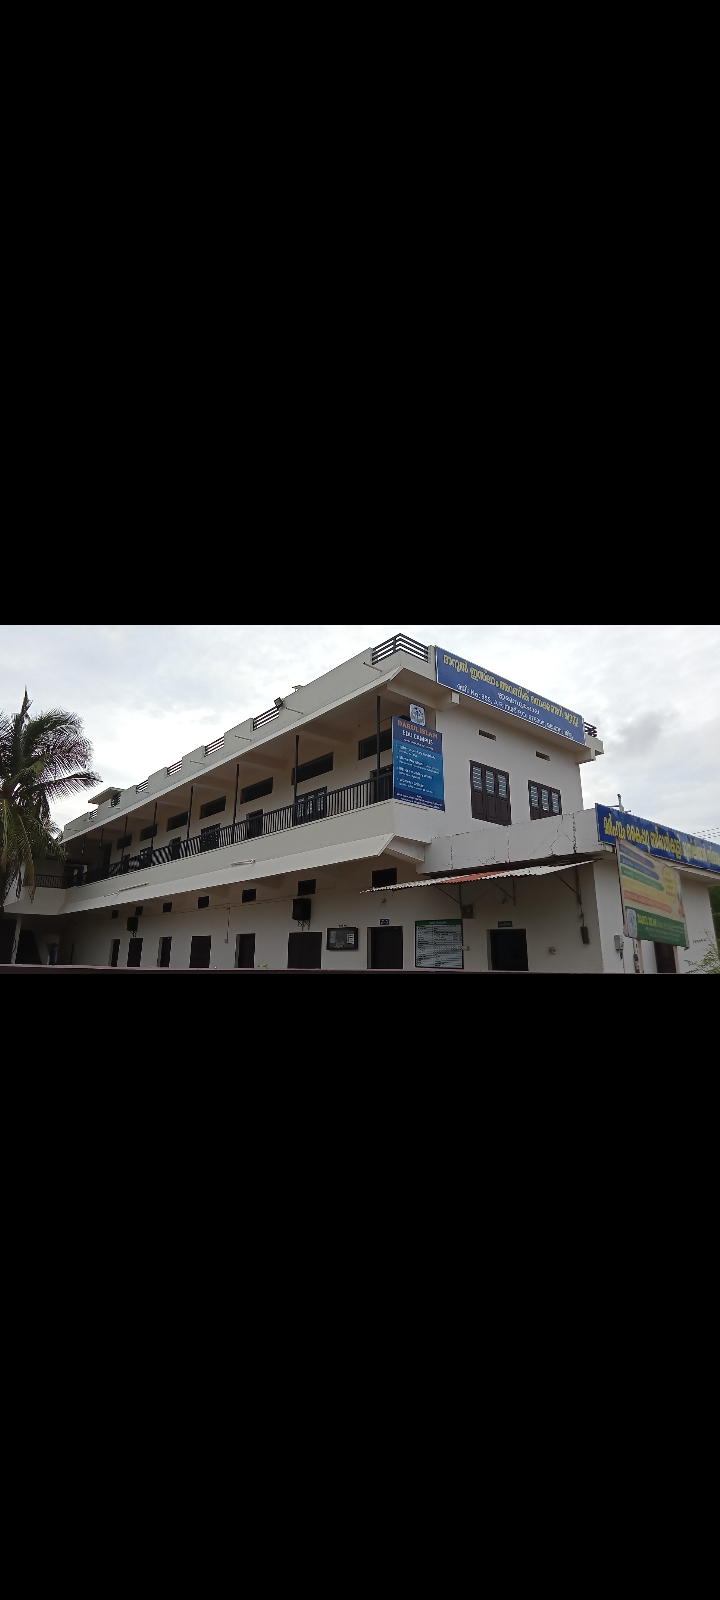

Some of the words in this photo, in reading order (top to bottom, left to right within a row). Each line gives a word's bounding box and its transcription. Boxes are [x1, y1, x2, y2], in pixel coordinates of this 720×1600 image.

[397, 719, 419, 732] DARUL
[402, 729, 412, 738] EDU
[413, 733, 433, 745] CAMPUS
